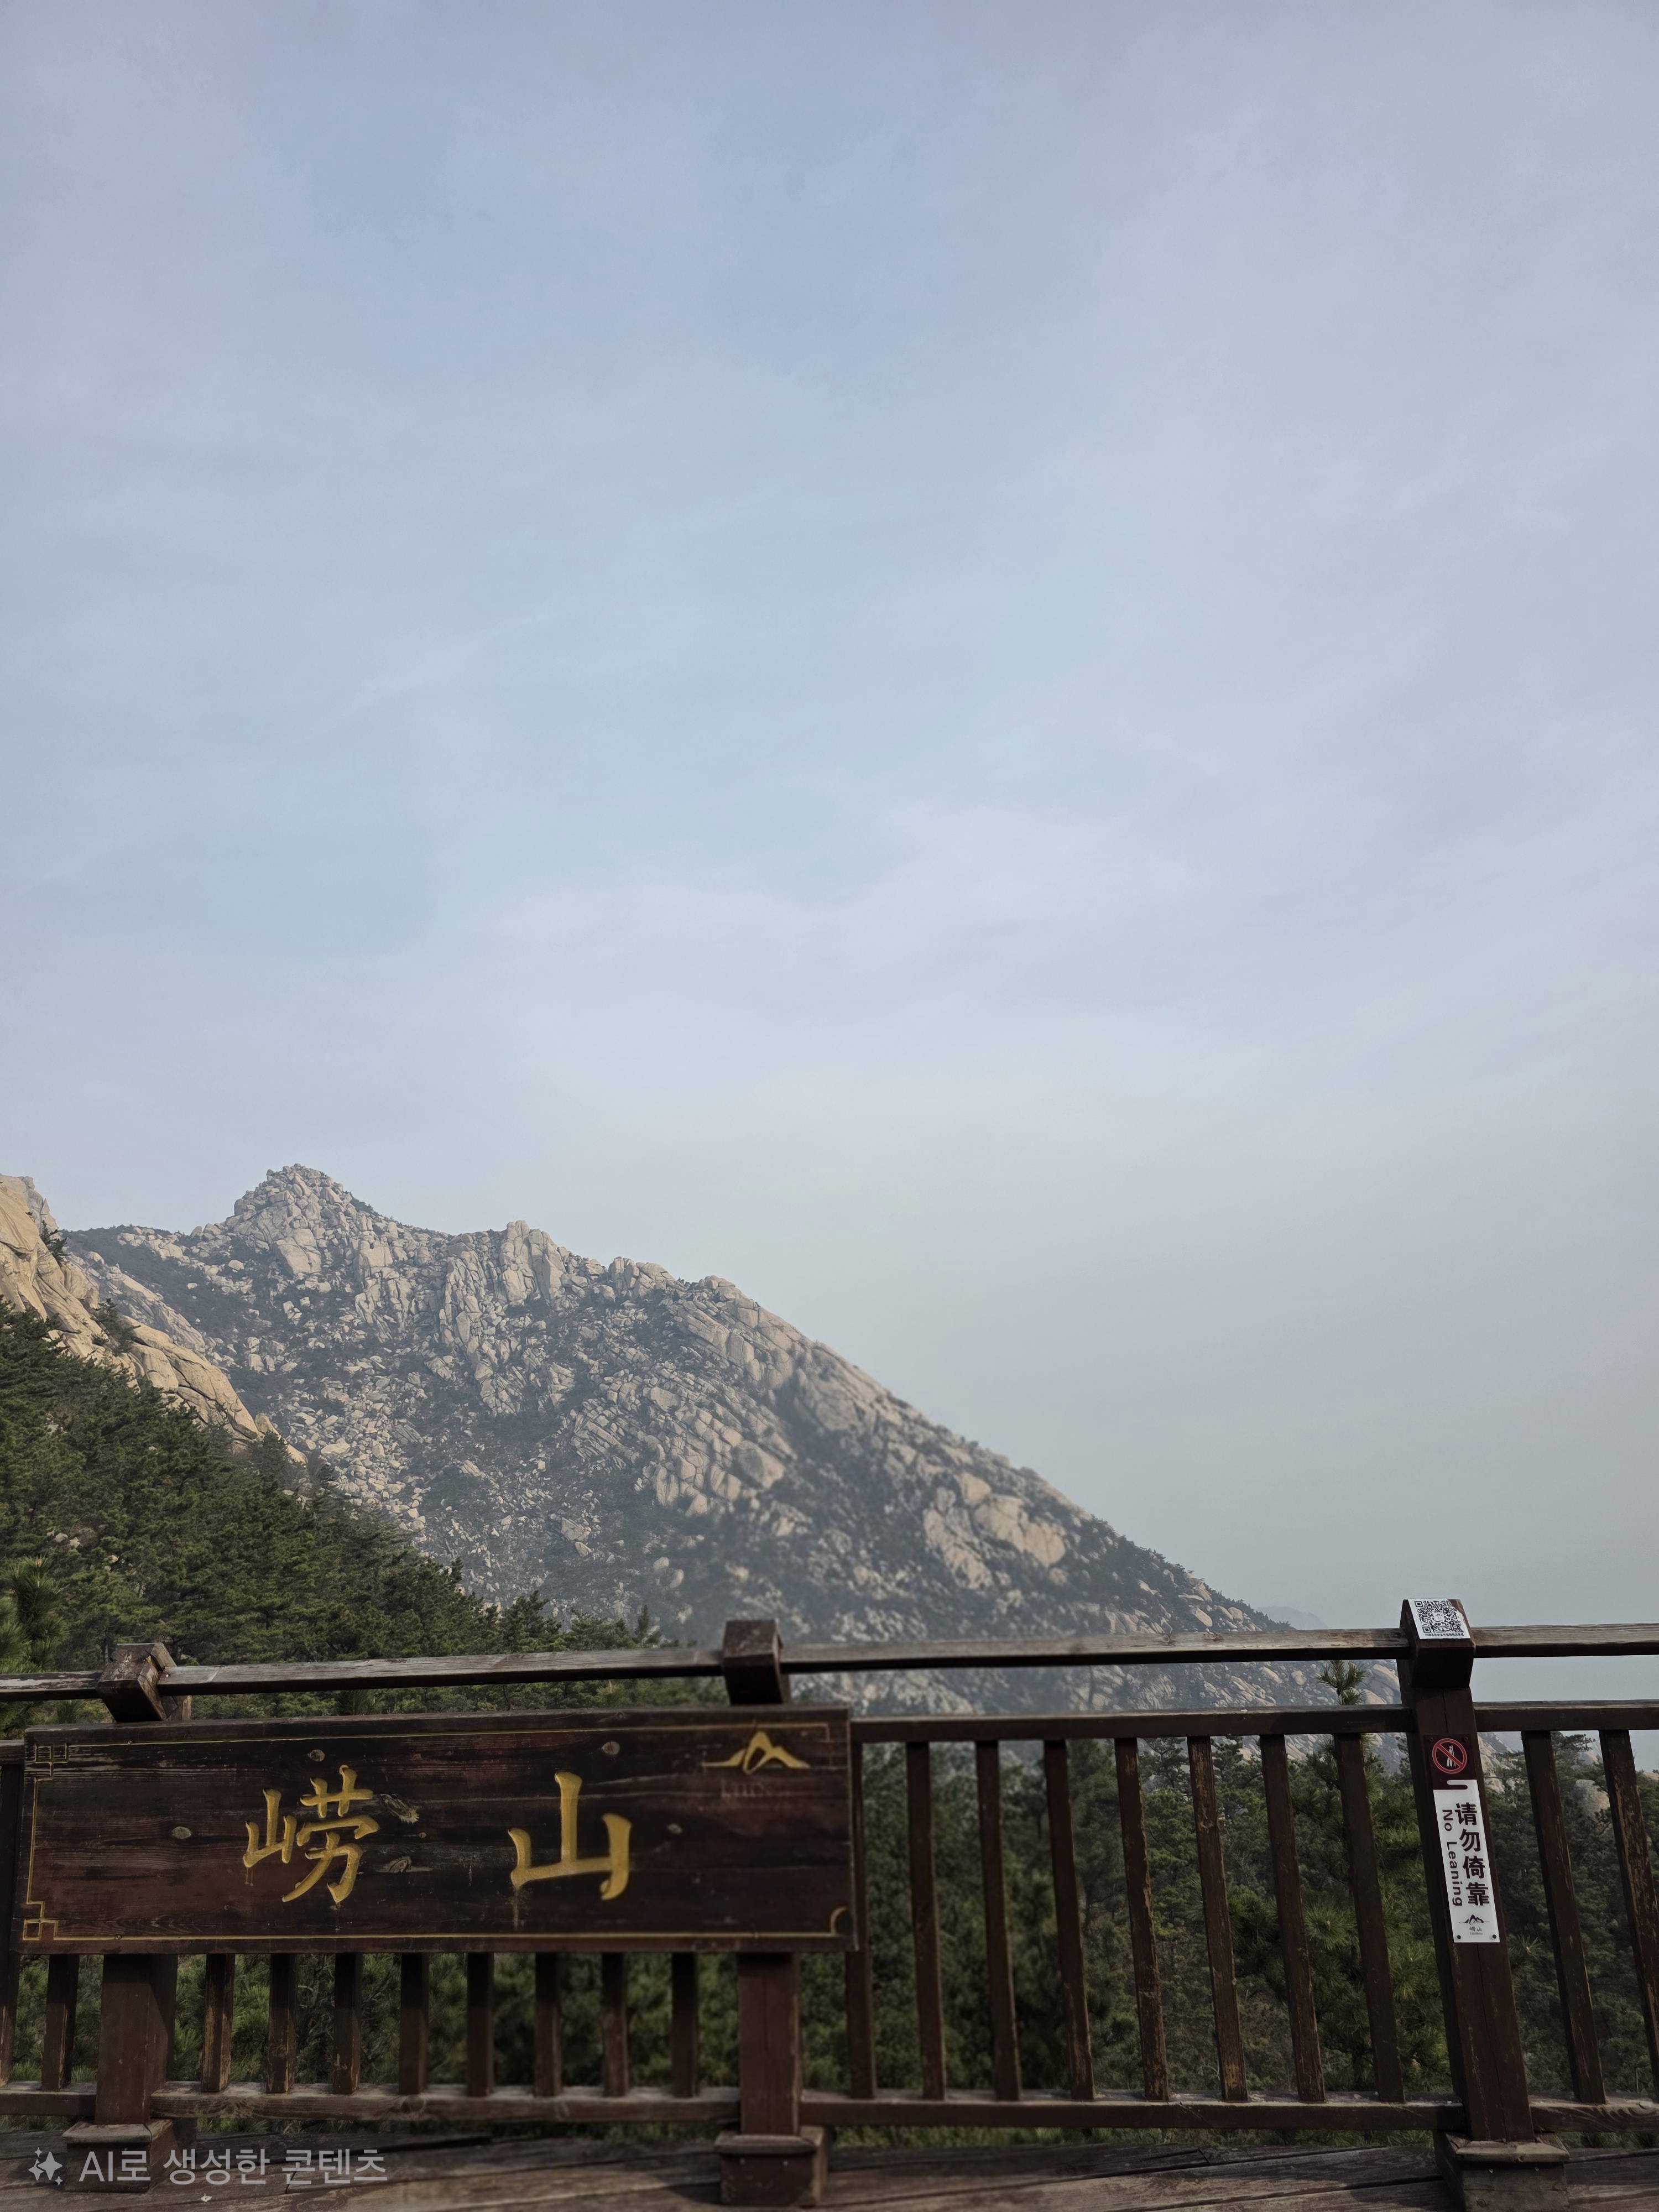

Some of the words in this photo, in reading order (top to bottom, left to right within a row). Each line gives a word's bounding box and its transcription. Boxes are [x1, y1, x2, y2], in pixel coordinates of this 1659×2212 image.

[243, 1765, 632, 1903] 崂山
[1442, 1809, 1454, 1832] No
[1454, 1802, 1490, 1906] 请勿倚靠
[1447, 1841, 1463, 1906] Leaning
